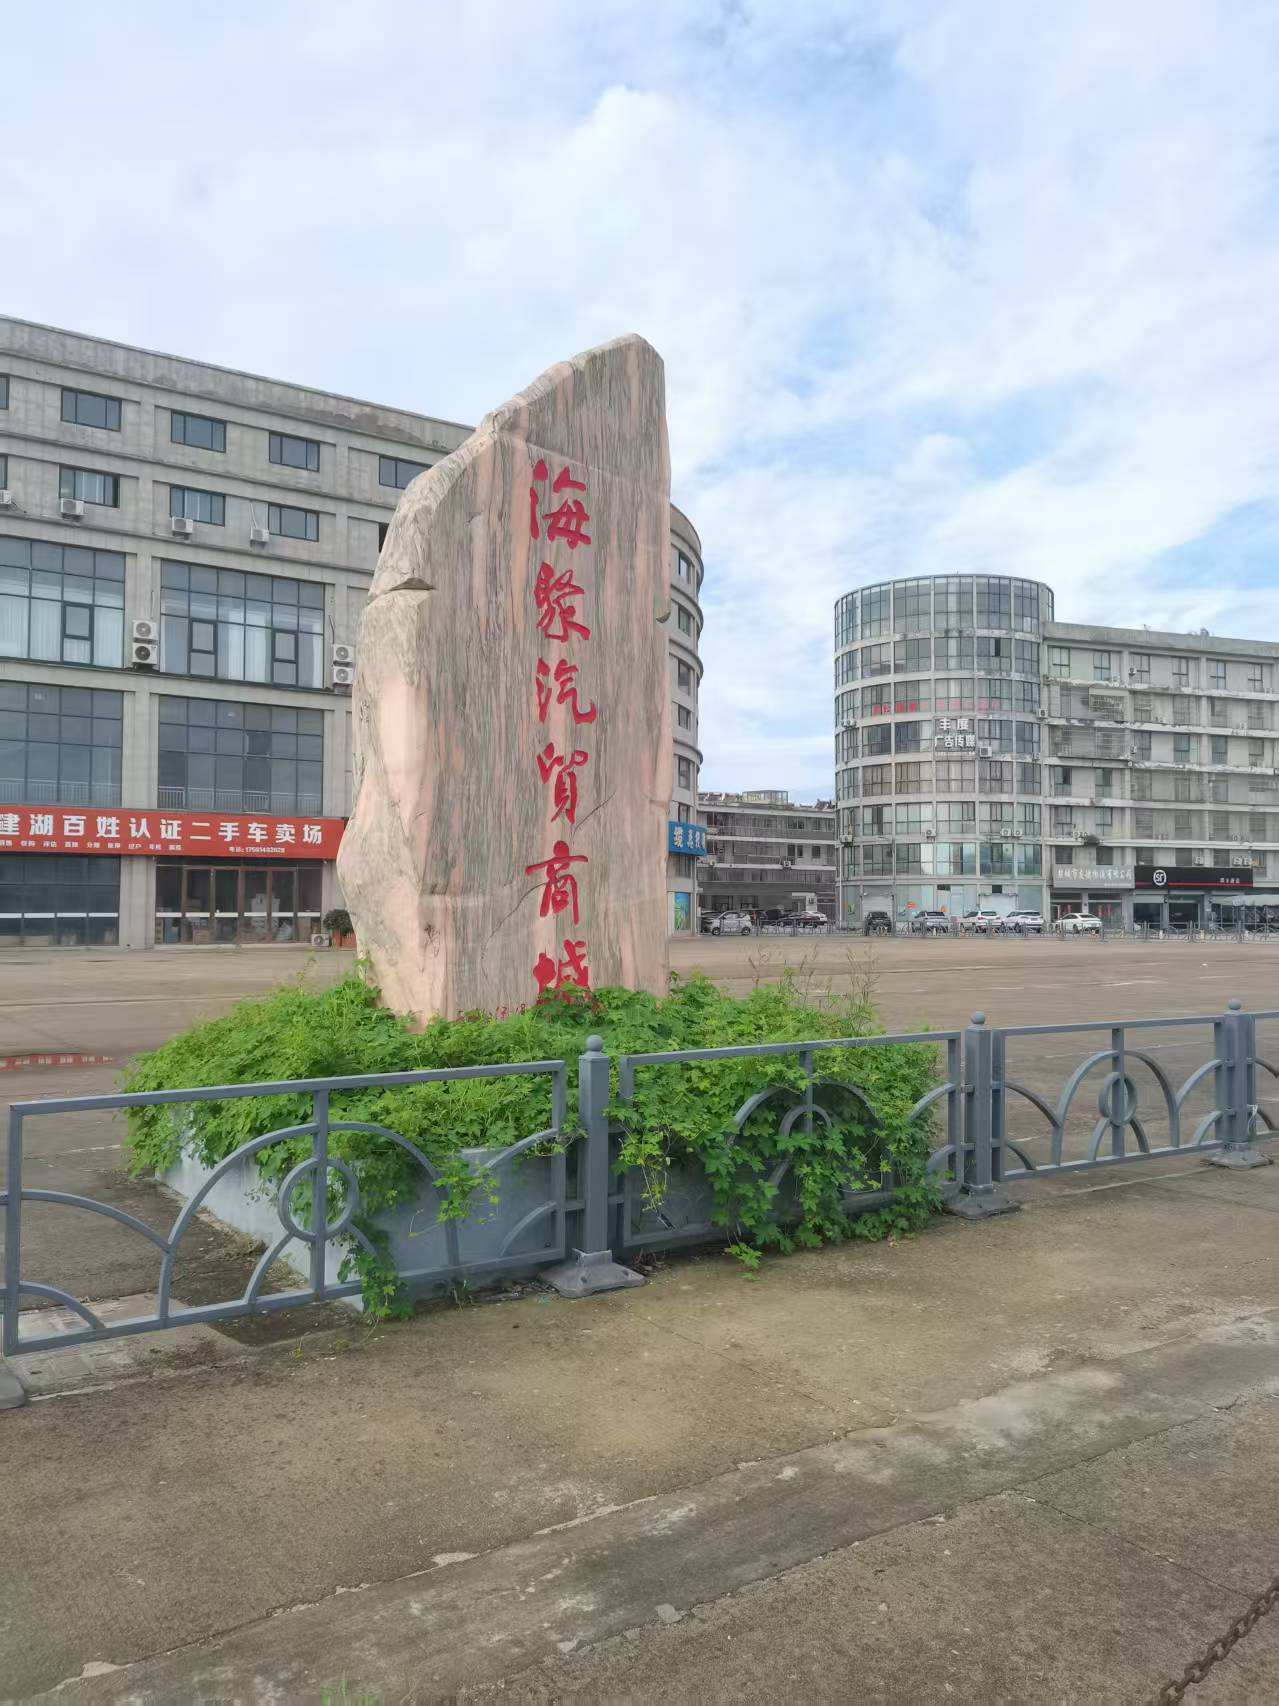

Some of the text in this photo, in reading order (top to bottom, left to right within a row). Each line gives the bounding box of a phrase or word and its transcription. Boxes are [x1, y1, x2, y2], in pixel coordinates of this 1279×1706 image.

[934, 735, 976, 747] 广告传媒
[0, 813, 323, 844] 建湖百姓认证二手车卖场
